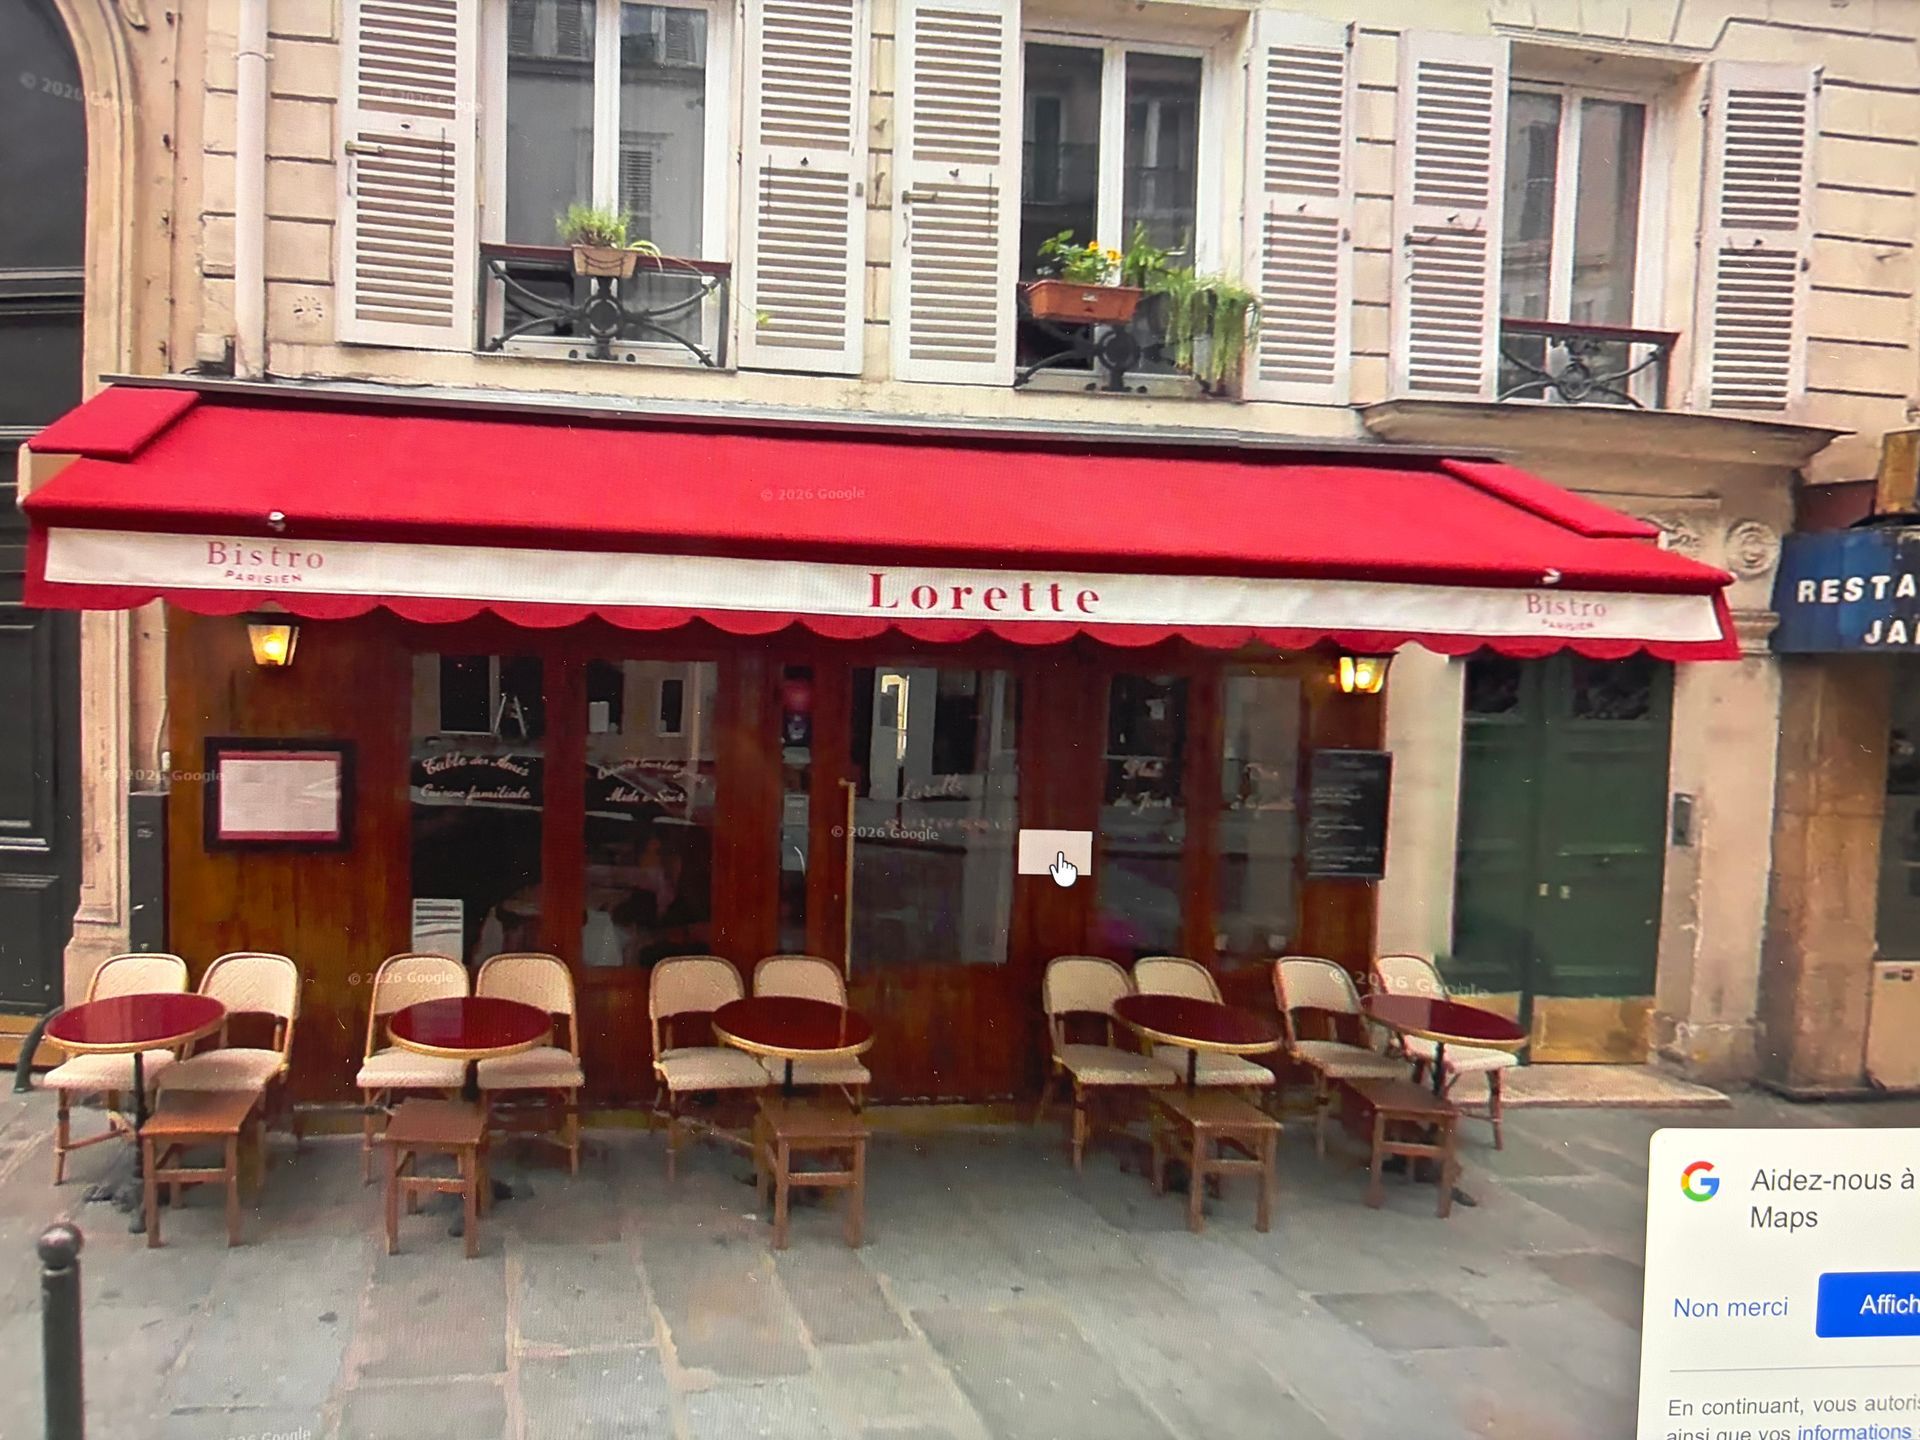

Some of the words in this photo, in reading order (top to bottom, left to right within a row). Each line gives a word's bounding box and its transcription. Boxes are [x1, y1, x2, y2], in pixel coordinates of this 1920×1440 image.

[207, 541, 324, 570] Bistro
[224, 569, 303, 584] PARISIEN
[1797, 573, 1917, 604] RESTA
[869, 573, 1100, 614] Lorette
[1526, 592, 1607, 617] Bistro
[1864, 619, 1920, 646] JA
[1750, 1168, 1892, 1192] Aidez-nous
[1900, 1166, 1915, 1190] à
[1750, 1205, 1819, 1234] Maps
[1673, 1297, 1719, 1318] Non
[1727, 1296, 1789, 1317] merci
[1859, 1293, 1920, 1316] Affich
[1668, 1399, 1694, 1417] En
[1701, 1397, 1804, 1416] continuant,
[1813, 1397, 1857, 1413] vous
[1666, 1427, 1711, 1440] ainsi
[1716, 1430, 1752, 1440] que
[1758, 1428, 1792, 1440] vos
[1798, 1422, 1912, 1440] informations
